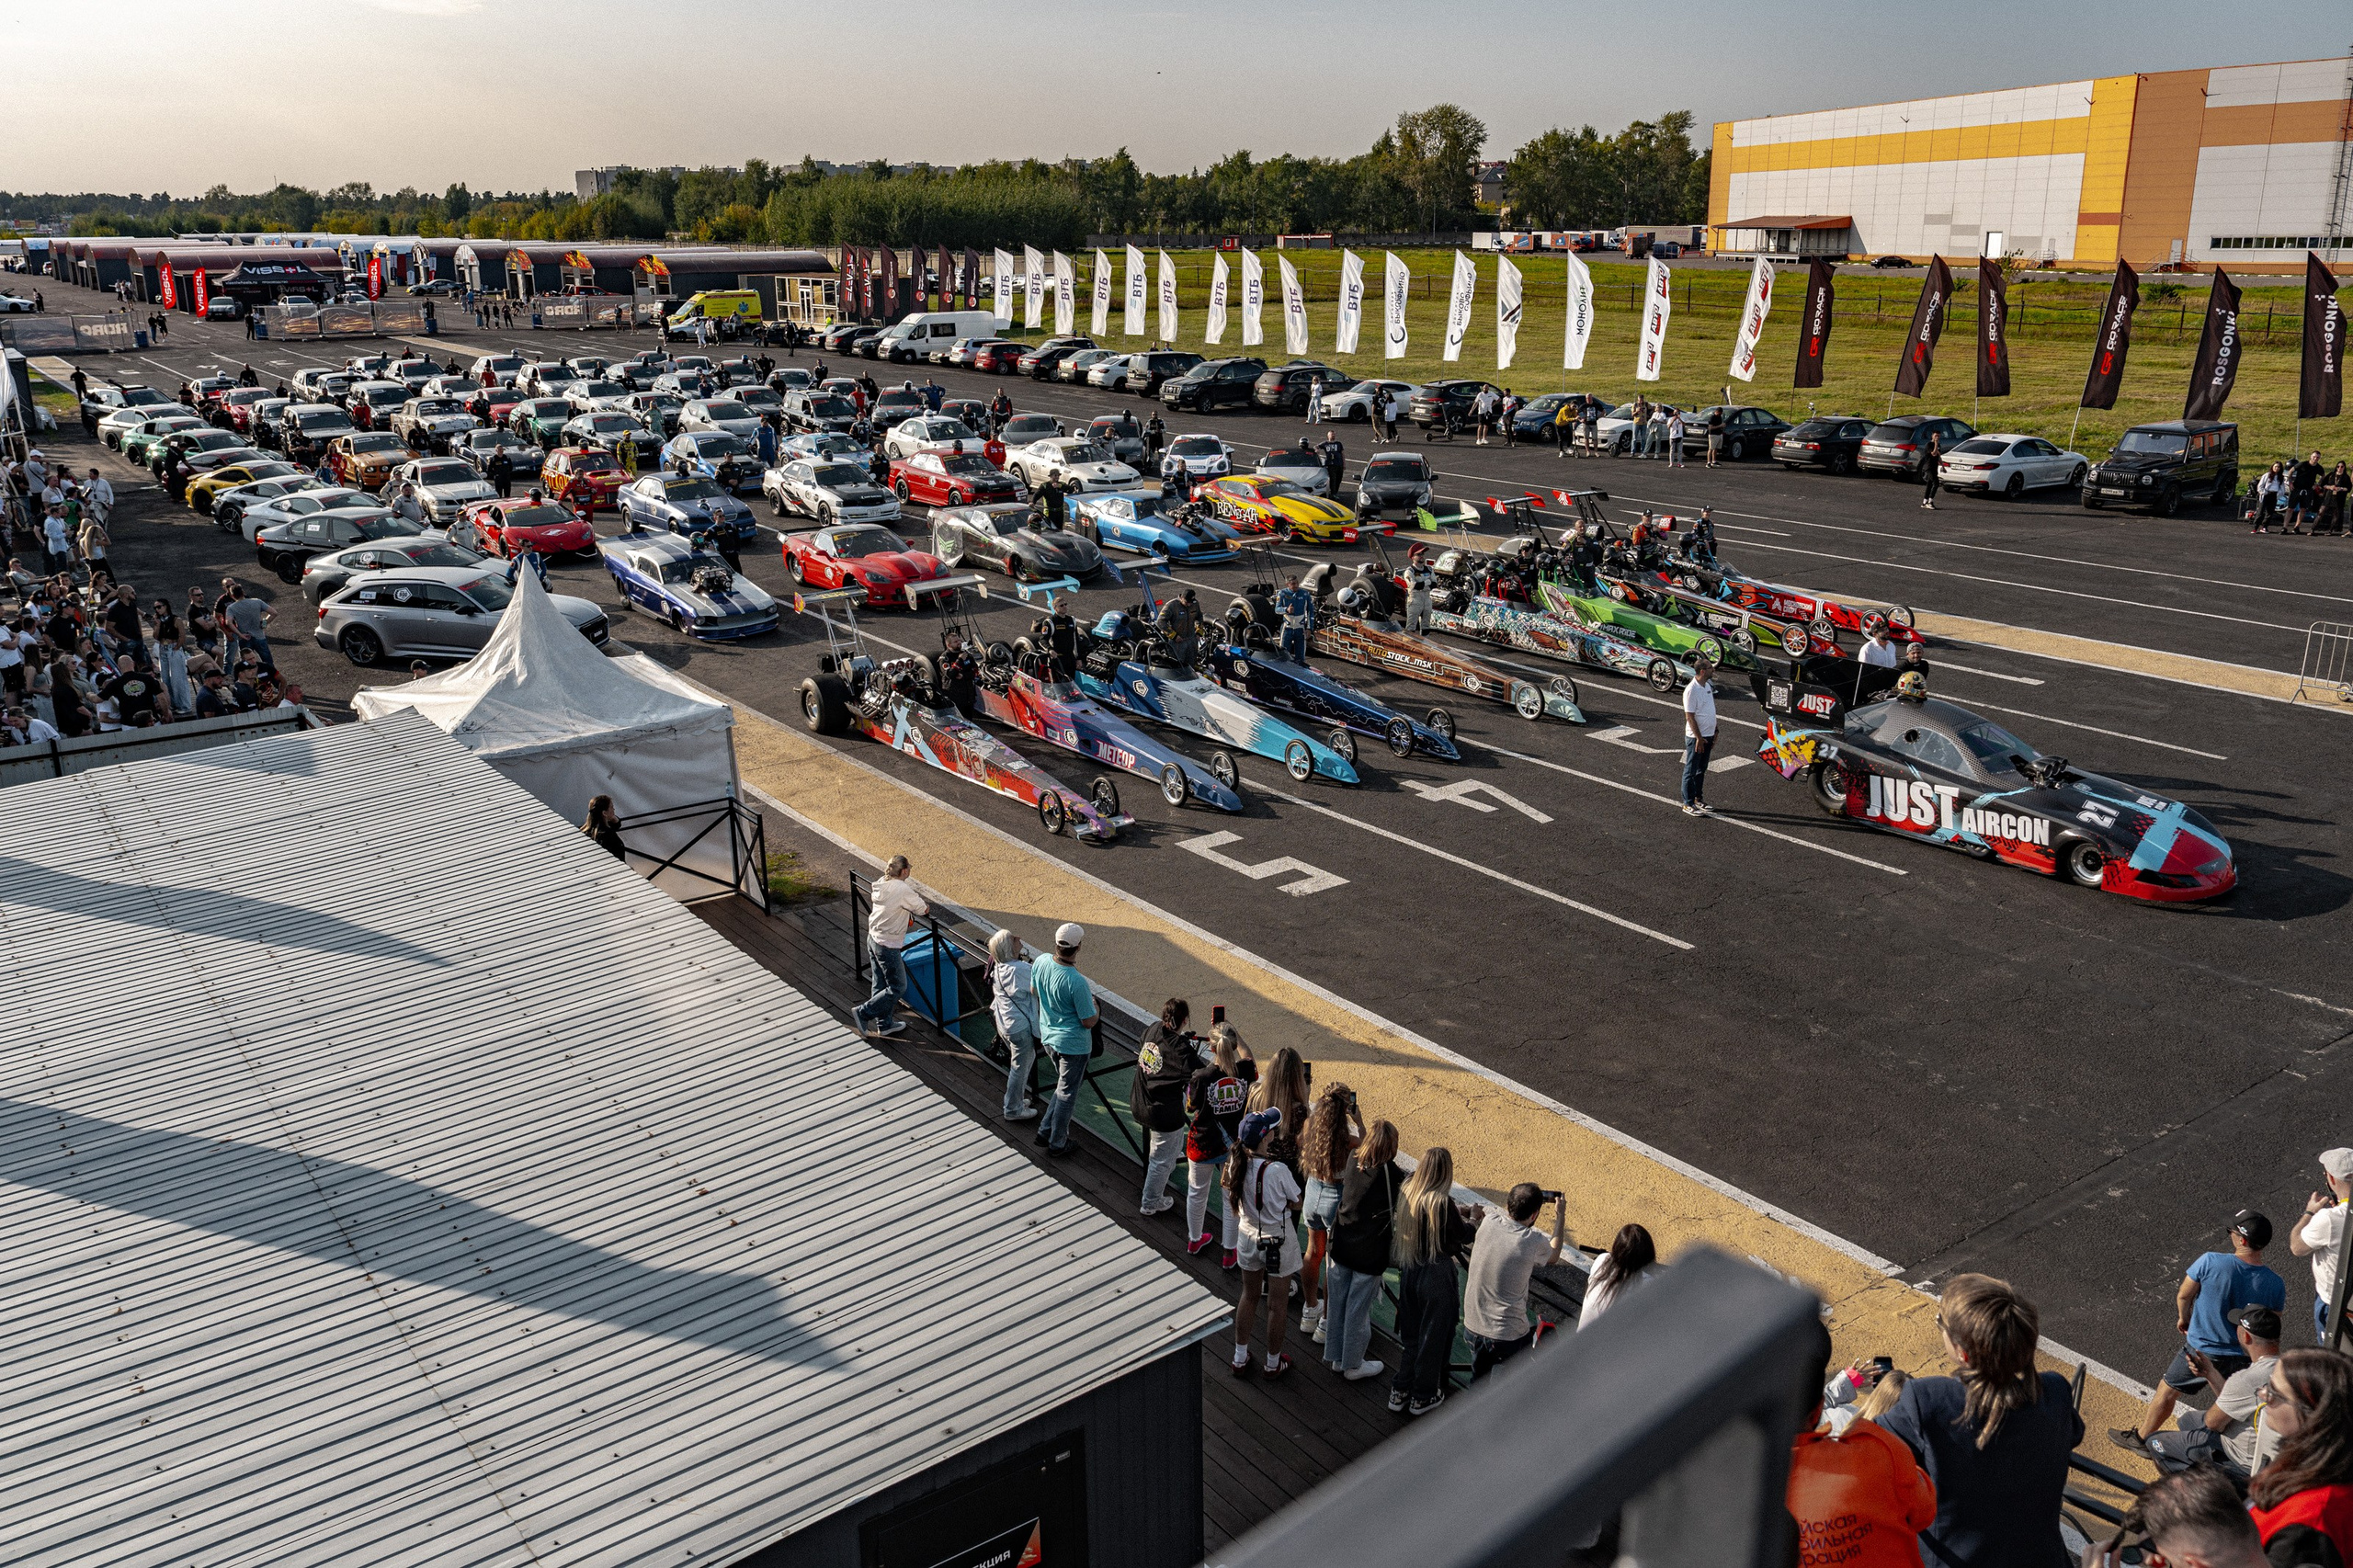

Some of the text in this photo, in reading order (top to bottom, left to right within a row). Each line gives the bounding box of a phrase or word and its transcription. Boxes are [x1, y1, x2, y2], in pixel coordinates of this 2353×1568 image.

[161, 267, 173, 305] VISSOL
[195, 271, 205, 312] VISSOL
[1000, 275, 1009, 296] ВТБ
[1031, 273, 1040, 295] ВТБ
[1061, 278, 1070, 300] ВТБ
[1097, 277, 1108, 300] ВТБ
[1132, 274, 1142, 297] ВТБ
[1163, 279, 1173, 303] ВТБ
[1214, 281, 1225, 306] ВТБ
[1249, 278, 1259, 304] ВТБ
[1347, 283, 1359, 311] ВТБ
[1457, 292, 1465, 326] БЫКОВО
[1575, 285, 1586, 335] МОНОЛИТ
[1748, 305, 1761, 335] АВТО
[1802, 693, 1832, 714] JUST
[1097, 741, 1137, 770] МЕТЕОР
[1818, 743, 1838, 760] 27
[1399, 778, 1554, 824] 4
[1867, 775, 2051, 846] JUST AIRCON
[1175, 829, 1351, 897] 5
[1217, 1085, 1240, 1102] GAT
[1214, 1104, 1243, 1115] FAMILY
[1799, 1513, 1858, 1536] йская
[1799, 1522, 1873, 1551] бильная
[1801, 1544, 1862, 1568] рация
